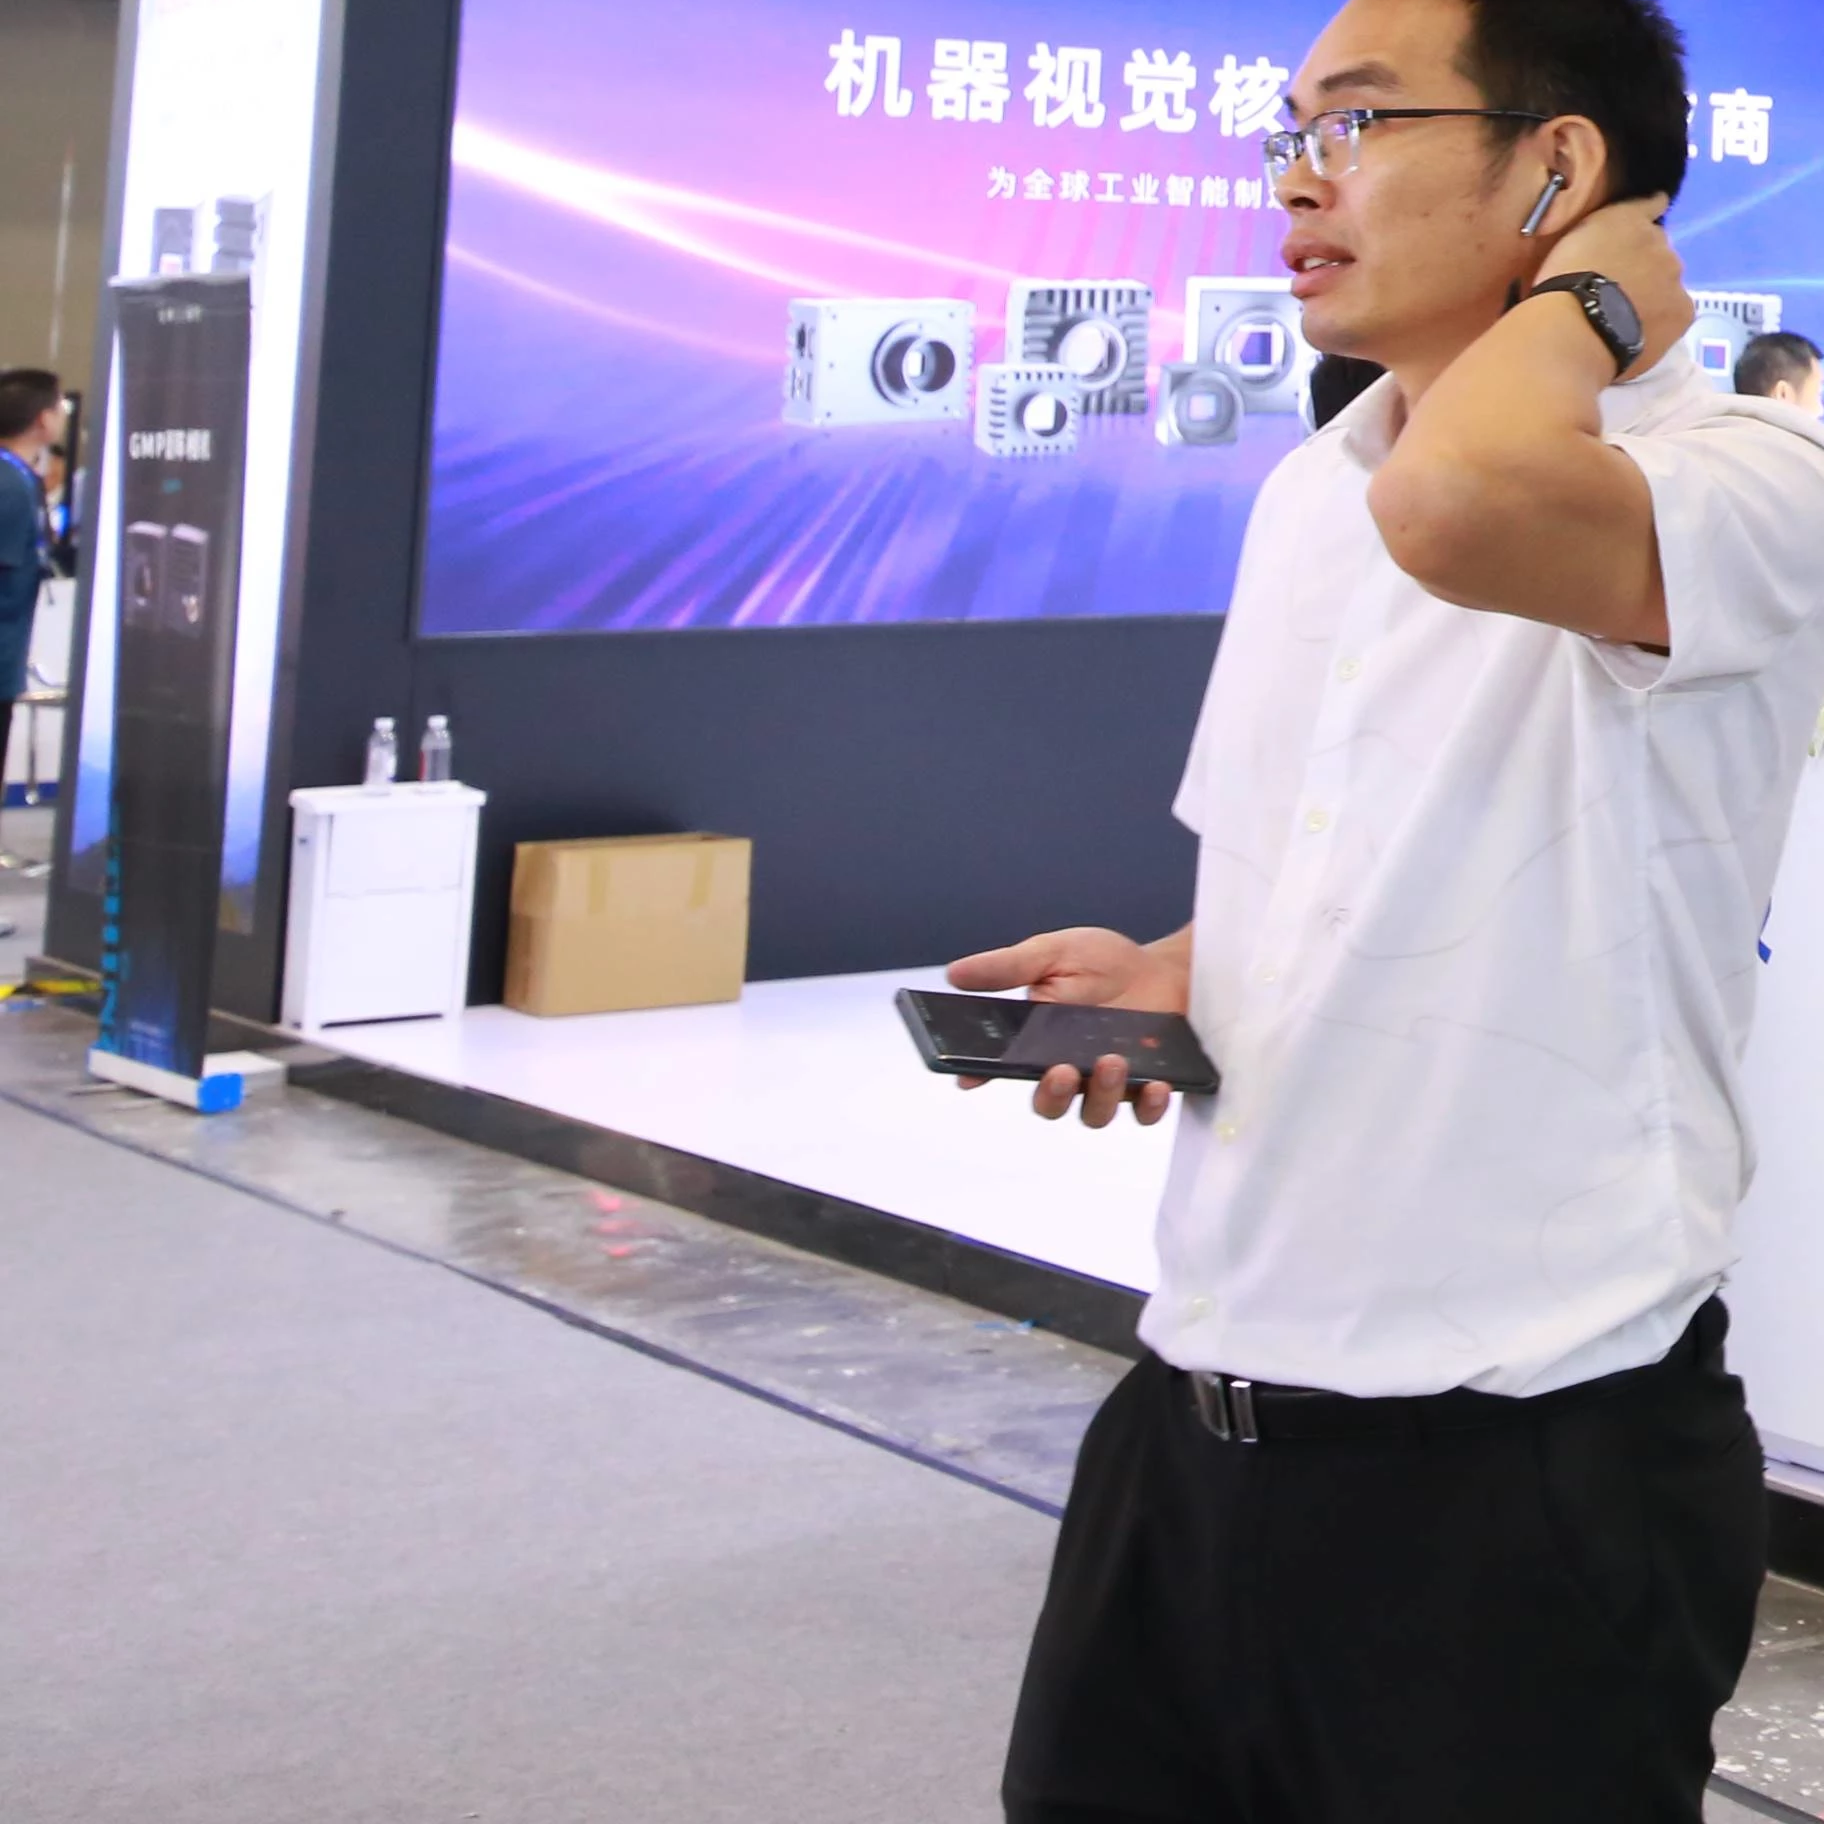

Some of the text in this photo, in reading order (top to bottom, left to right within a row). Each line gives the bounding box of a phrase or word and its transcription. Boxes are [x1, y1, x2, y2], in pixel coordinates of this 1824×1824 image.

[825, 29, 1290, 138] 机器视觉核
